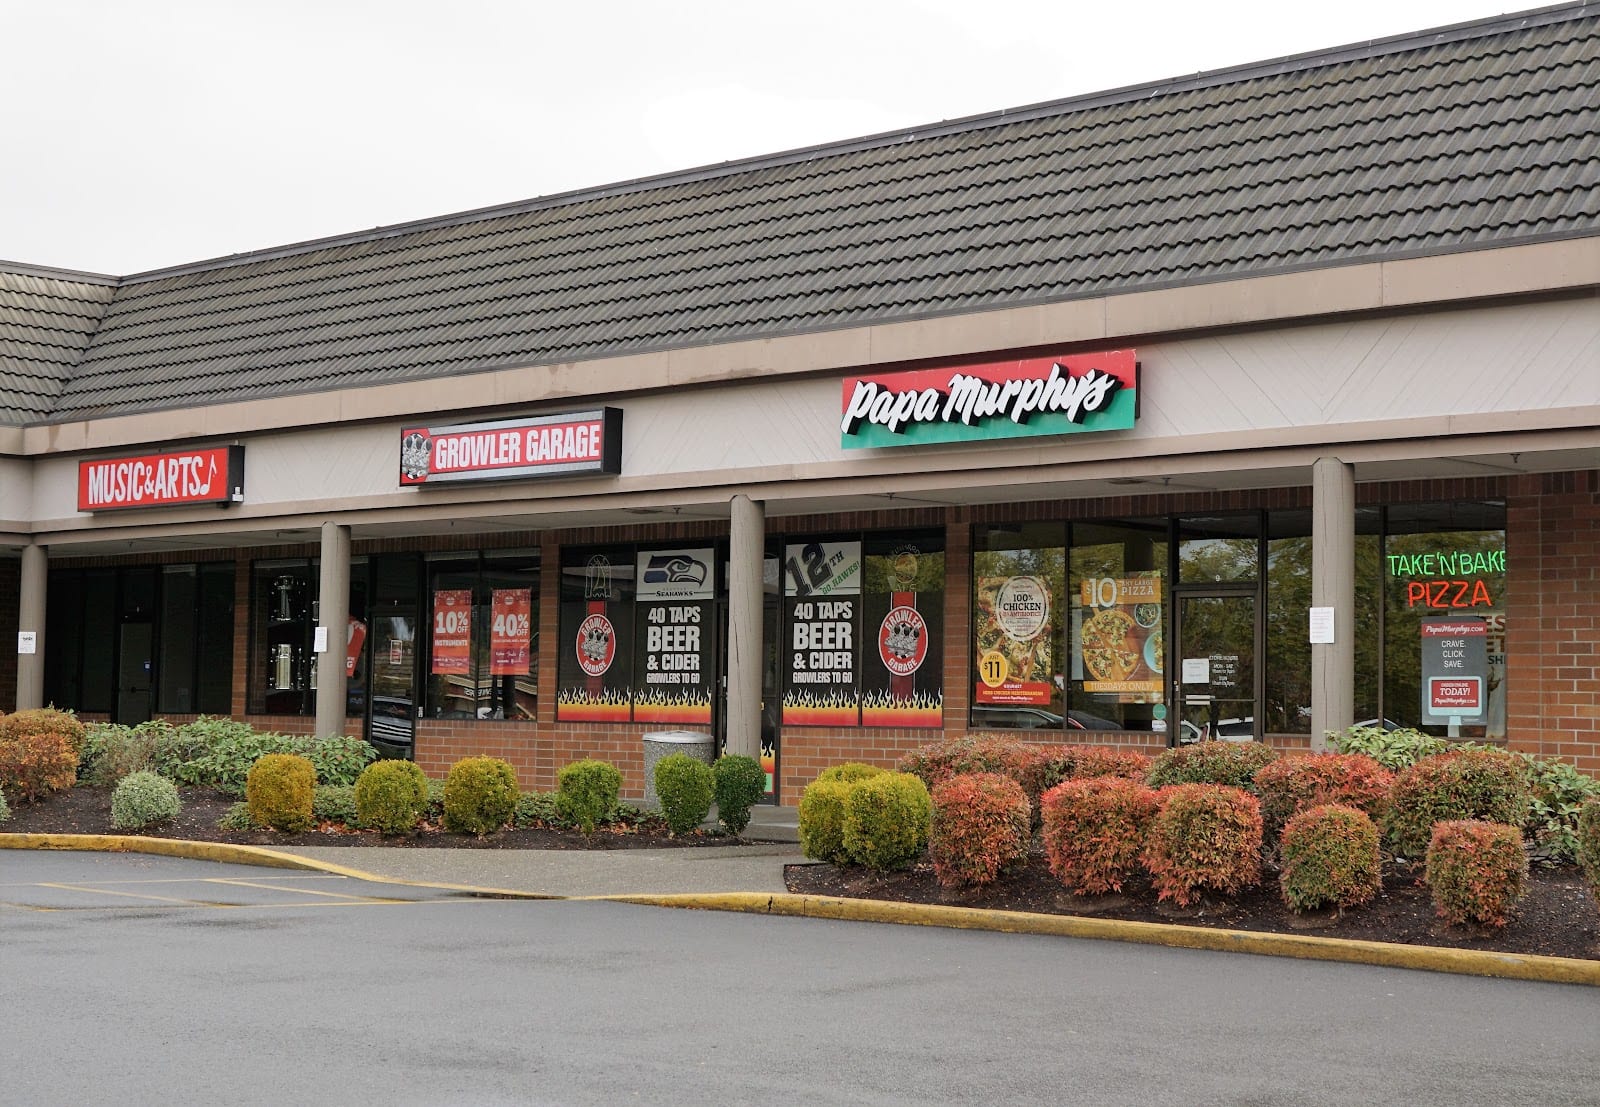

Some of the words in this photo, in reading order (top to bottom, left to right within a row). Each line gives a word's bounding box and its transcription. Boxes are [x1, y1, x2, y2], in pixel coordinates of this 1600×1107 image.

[840, 380, 940, 435] Papa
[942, 363, 1116, 426] Murphy's
[435, 431, 521, 470] GROWLER
[526, 424, 601, 462] GARAGE
[88, 455, 204, 505] MUSIC&ARTS
[1013, 593, 1034, 602] 100%
[1121, 585, 1154, 595] PIZZA
[1407, 579, 1494, 608] PIZZA
[648, 607, 666, 624] 40
[669, 606, 701, 623] TAPS
[793, 602, 814, 620] 40
[817, 601, 853, 620] TAPS
[1003, 602, 1042, 611] CHICKEN
[435, 611, 469, 634] 10%
[493, 613, 529, 637] 40%
[581, 617, 612, 636] GROWLER
[885, 609, 923, 632] GROWLER
[457, 626, 469, 634] OFF
[516, 628, 529, 636] OFF
[647, 625, 700, 652] BEER
[793, 621, 852, 650] BEER
[647, 654, 659, 671] &
[661, 654, 700, 670] CIDER
[793, 652, 806, 670] &
[809, 652, 853, 670] CIDER
[887, 657, 918, 672] GARAGE
[984, 661, 1000, 679] $11
[646, 672, 680, 684] GROWLERS
[680, 672, 690, 684] TO
[690, 672, 700, 684] GO
[792, 671, 831, 684] GROWLERS
[831, 671, 840, 684] TO
[841, 671, 853, 684] GO
[1090, 681, 1128, 691] TUESDAYS
[1440, 687, 1471, 696] TODAY!
